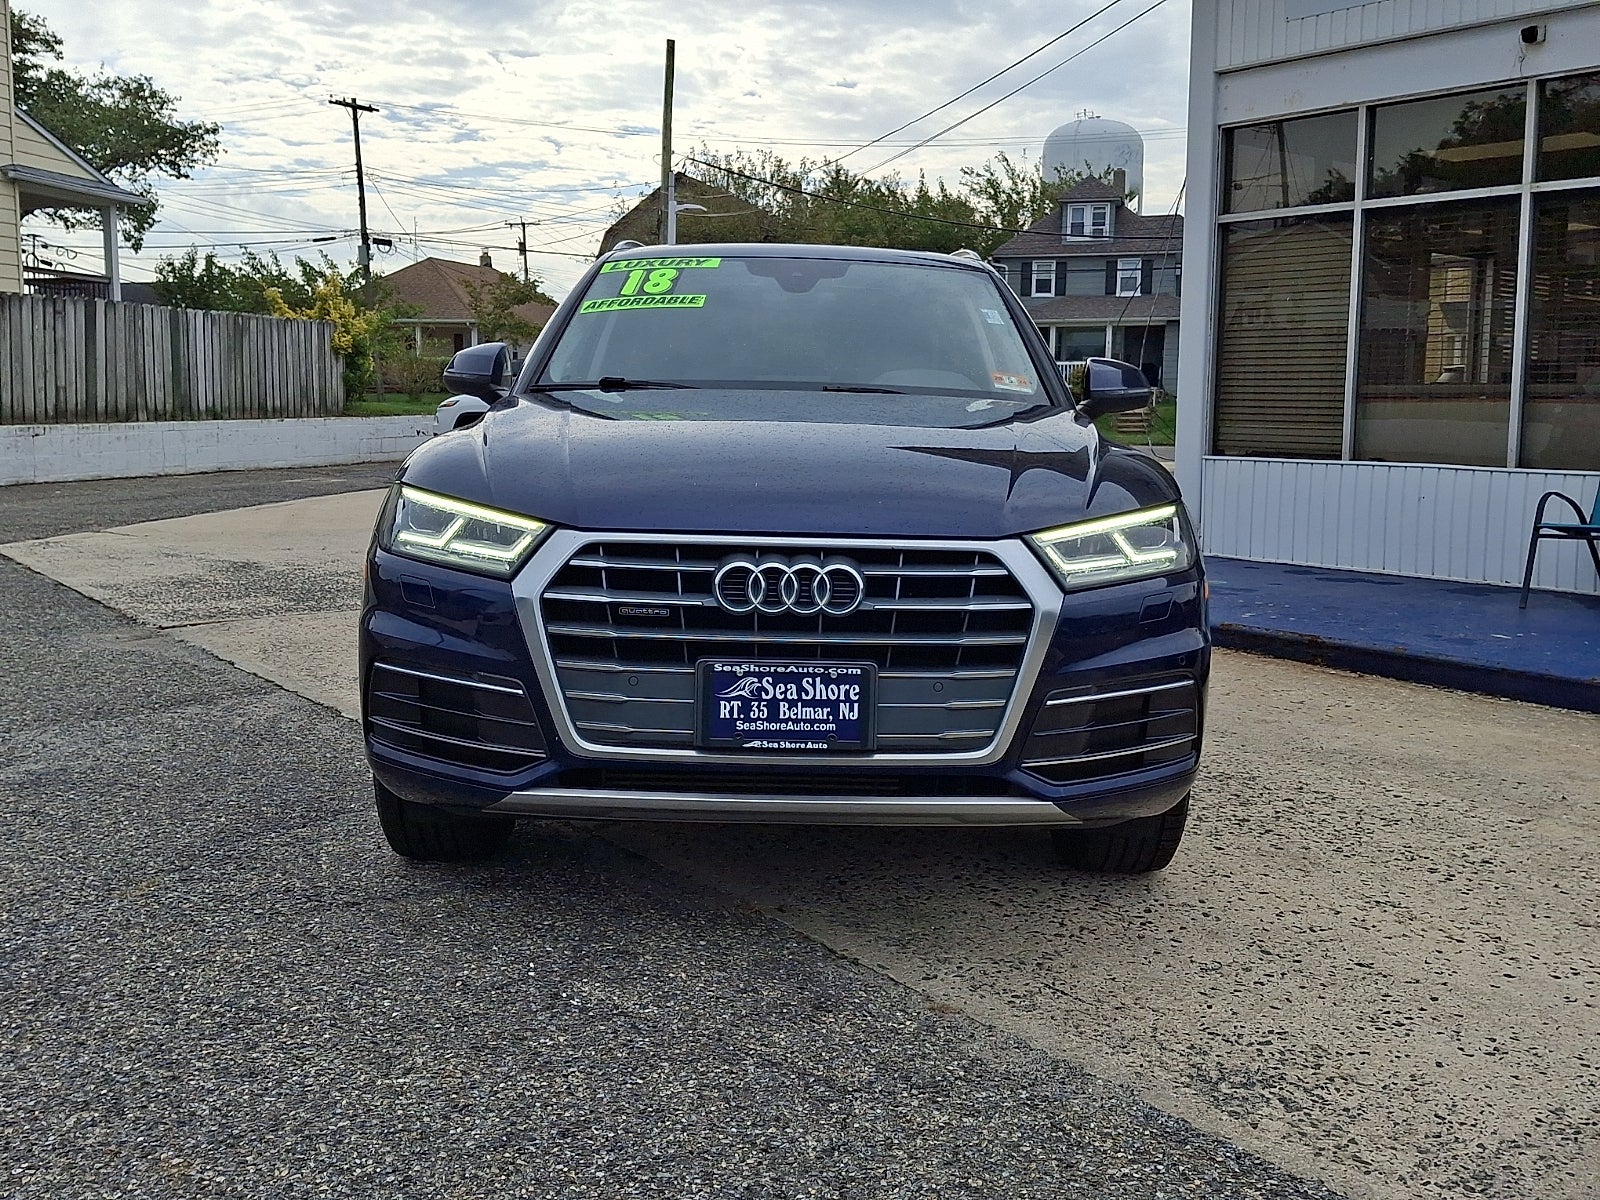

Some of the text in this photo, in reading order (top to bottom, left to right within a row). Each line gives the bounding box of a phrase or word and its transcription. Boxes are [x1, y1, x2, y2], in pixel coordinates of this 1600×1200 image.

[609, 259, 709, 270] LUXURY
[620, 268, 679, 296] 18
[713, 663, 862, 675] SeaShoreAuto.com
[761, 676, 860, 700] Sea Shore
[719, 701, 859, 722] RT. 35 Belmar, NJ
[735, 720, 836, 731] SeaShoreAuto.com
[761, 741, 828, 749] Sea Shore Auto
